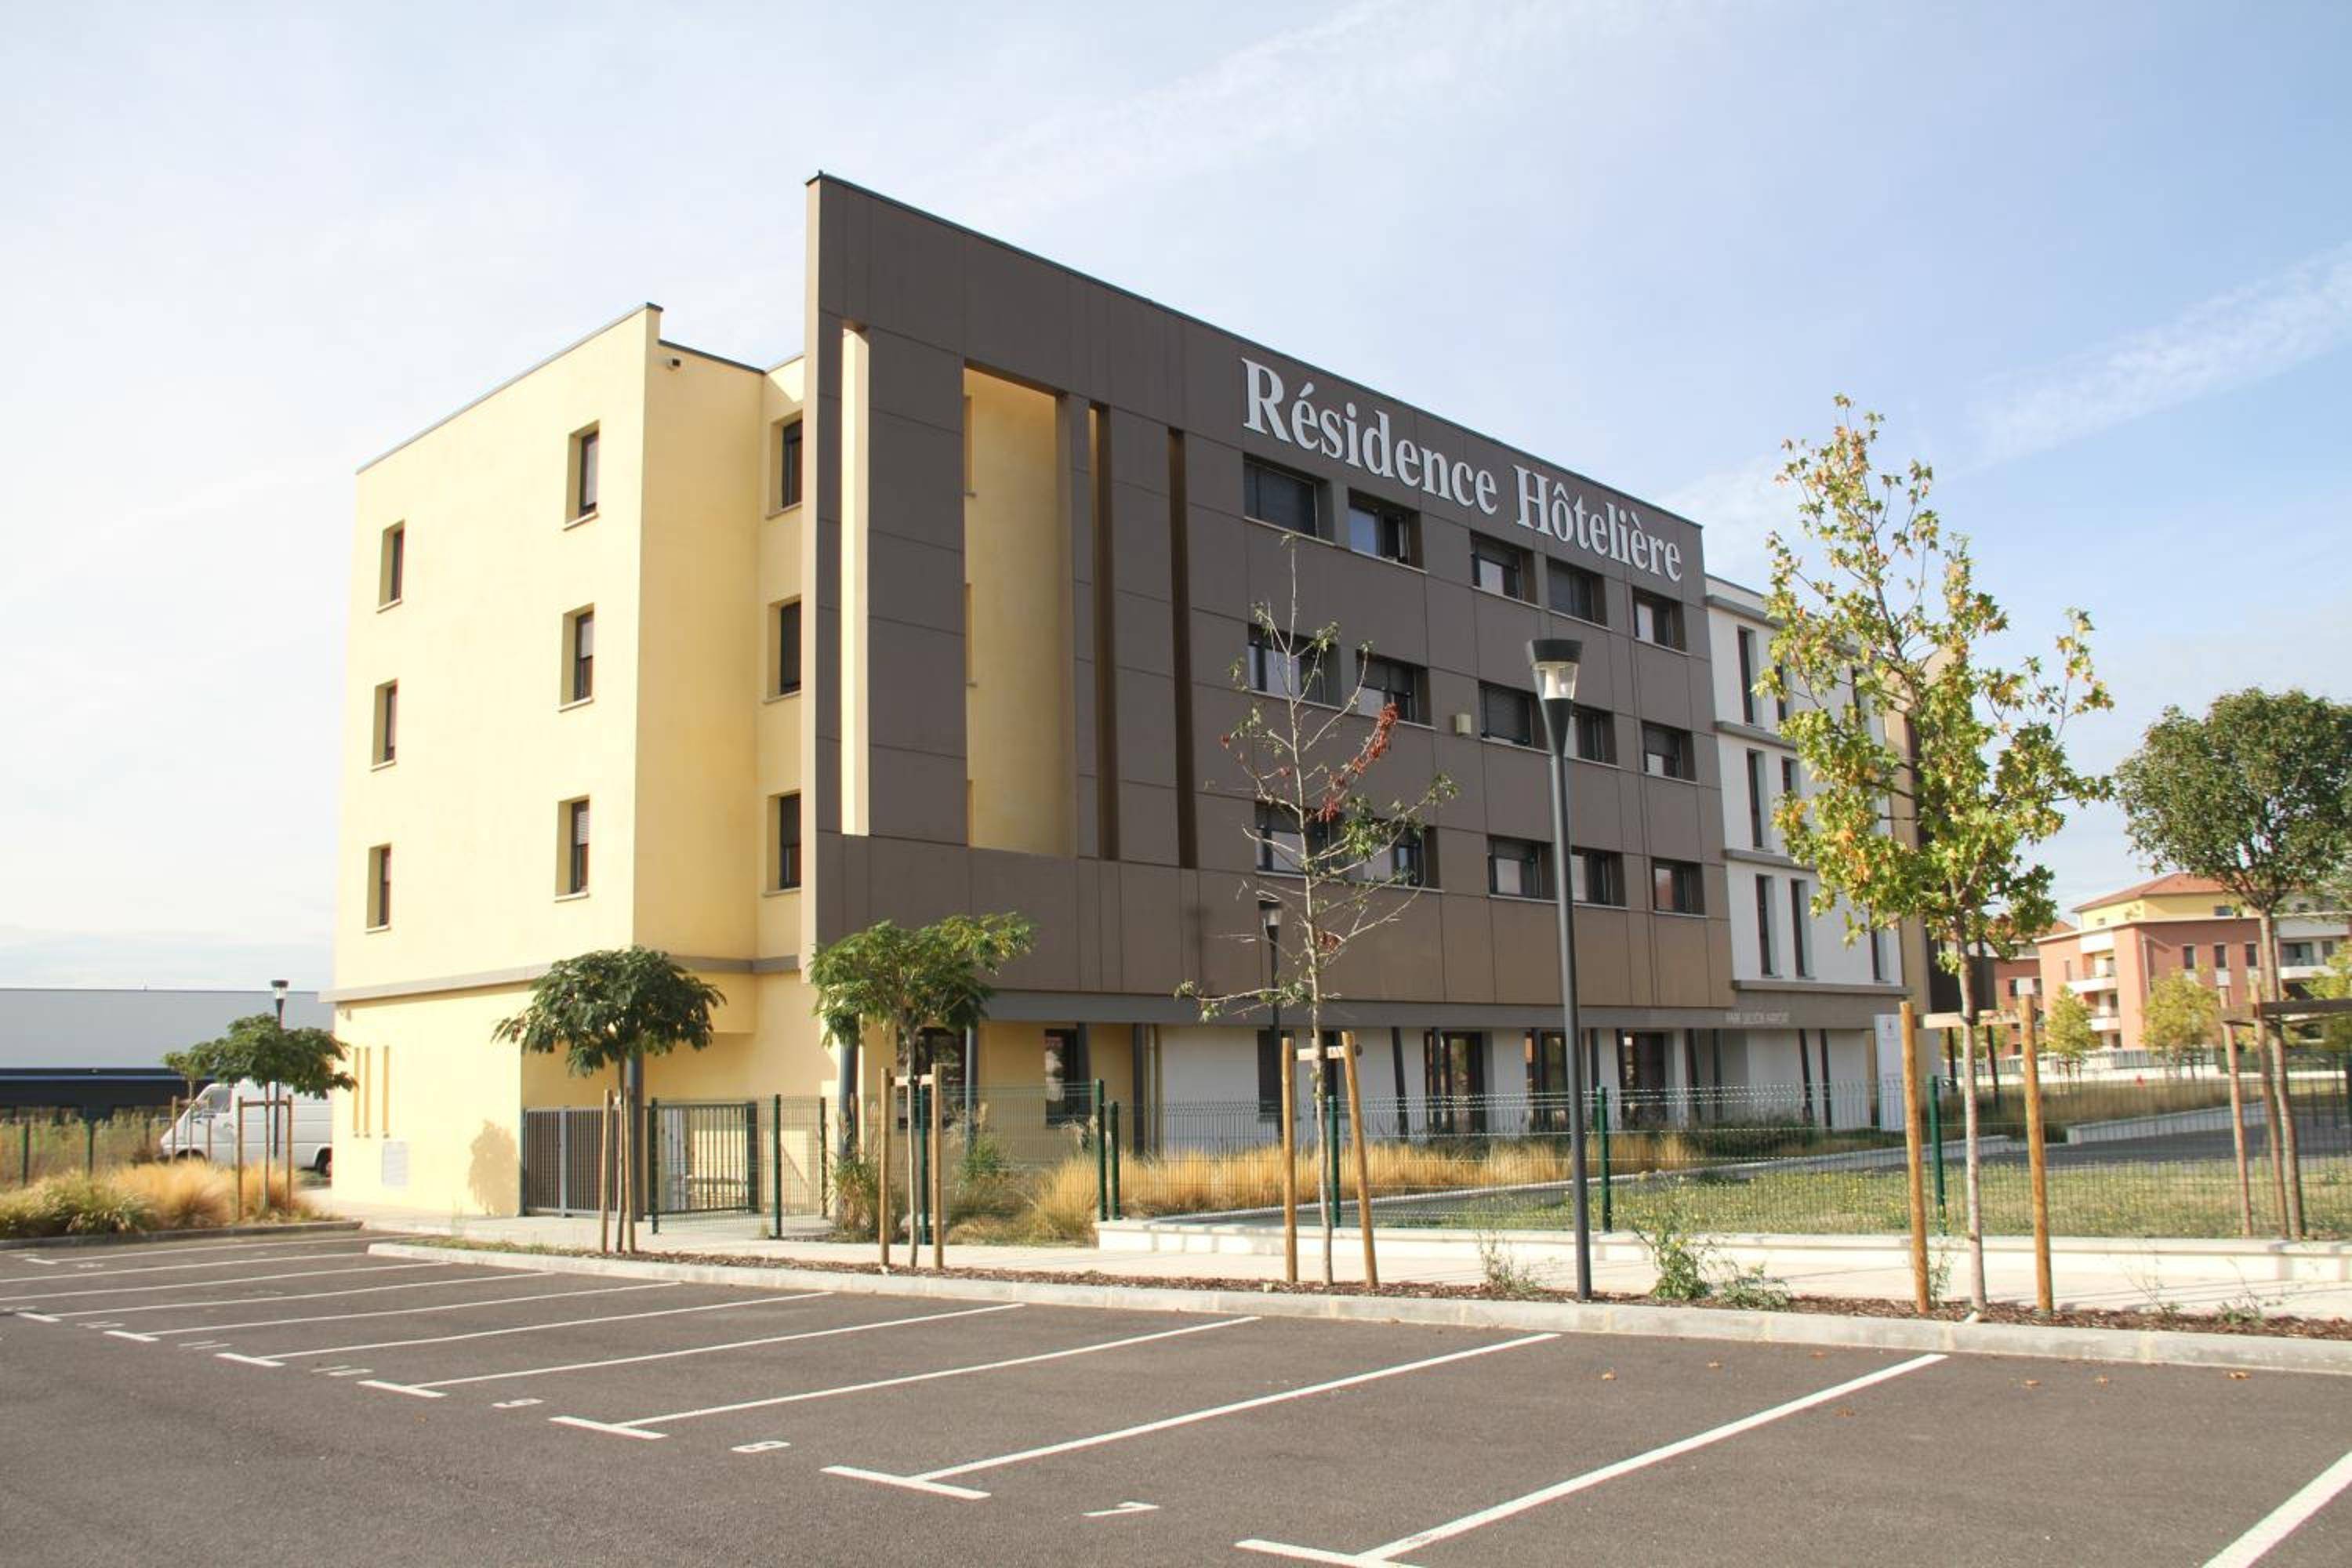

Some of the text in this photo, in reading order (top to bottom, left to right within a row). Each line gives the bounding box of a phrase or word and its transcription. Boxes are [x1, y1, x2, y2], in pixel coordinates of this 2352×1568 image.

[1241, 357, 1682, 583] Résidence Hôtelière
[310, 1364, 375, 1377] 10
[492, 1398, 546, 1409] 9
[731, 1439, 792, 1454] 8
[1081, 1501, 1160, 1517] 7
